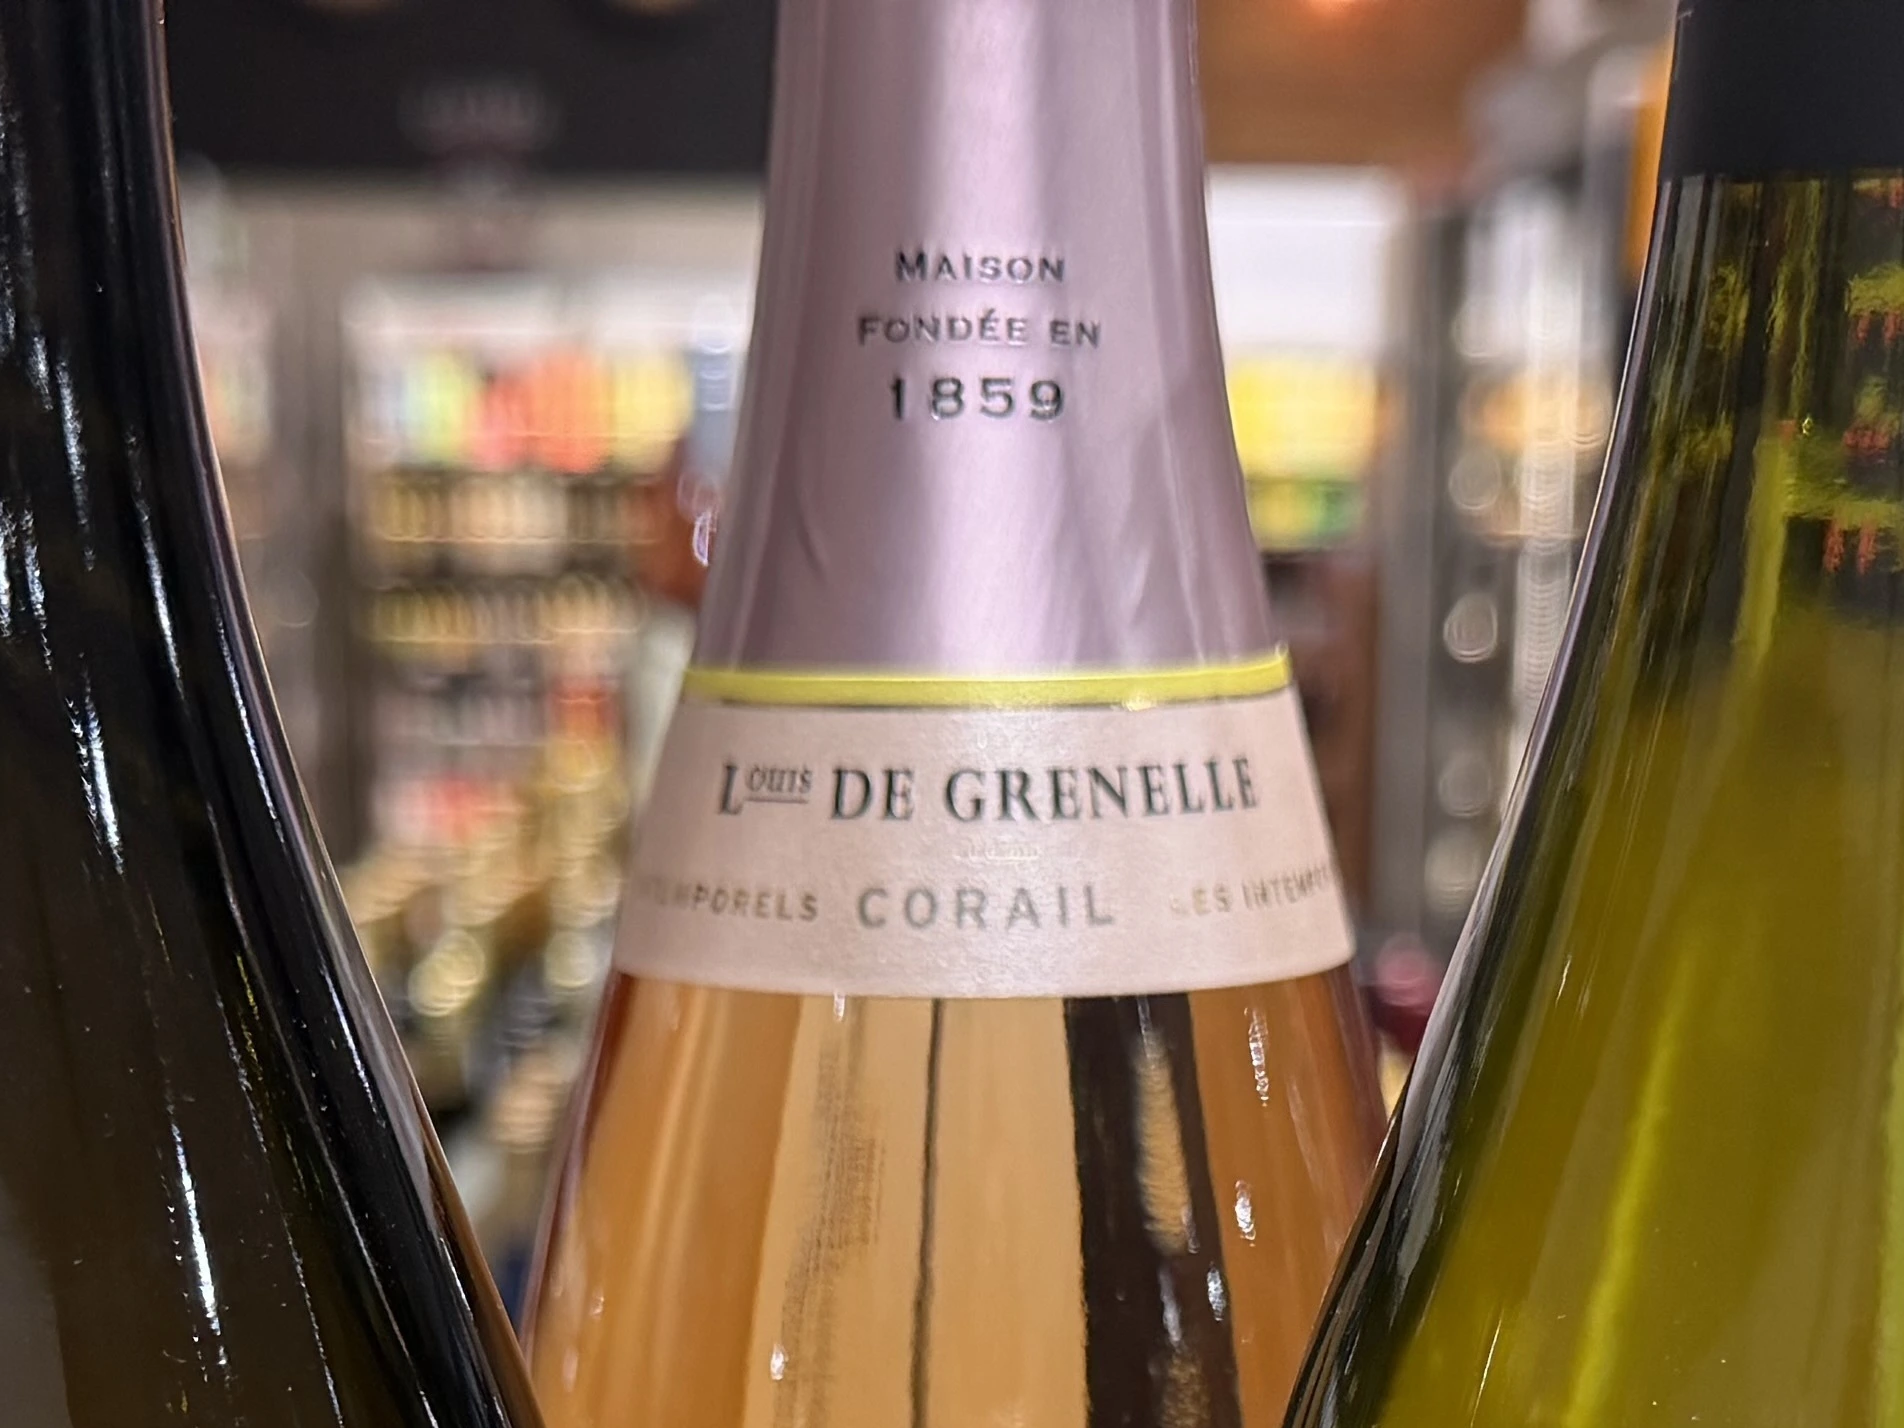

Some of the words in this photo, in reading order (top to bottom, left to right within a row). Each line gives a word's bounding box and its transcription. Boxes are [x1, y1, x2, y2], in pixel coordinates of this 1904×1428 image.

[897, 252, 1065, 283] MAISON
[858, 309, 1027, 346] FONDÉE
[1049, 321, 1100, 347] EN
[891, 377, 1065, 421] 1859
[831, 767, 915, 821] DE
[946, 758, 1259, 823] GRENELLE
[857, 884, 1117, 931] CORAIL
